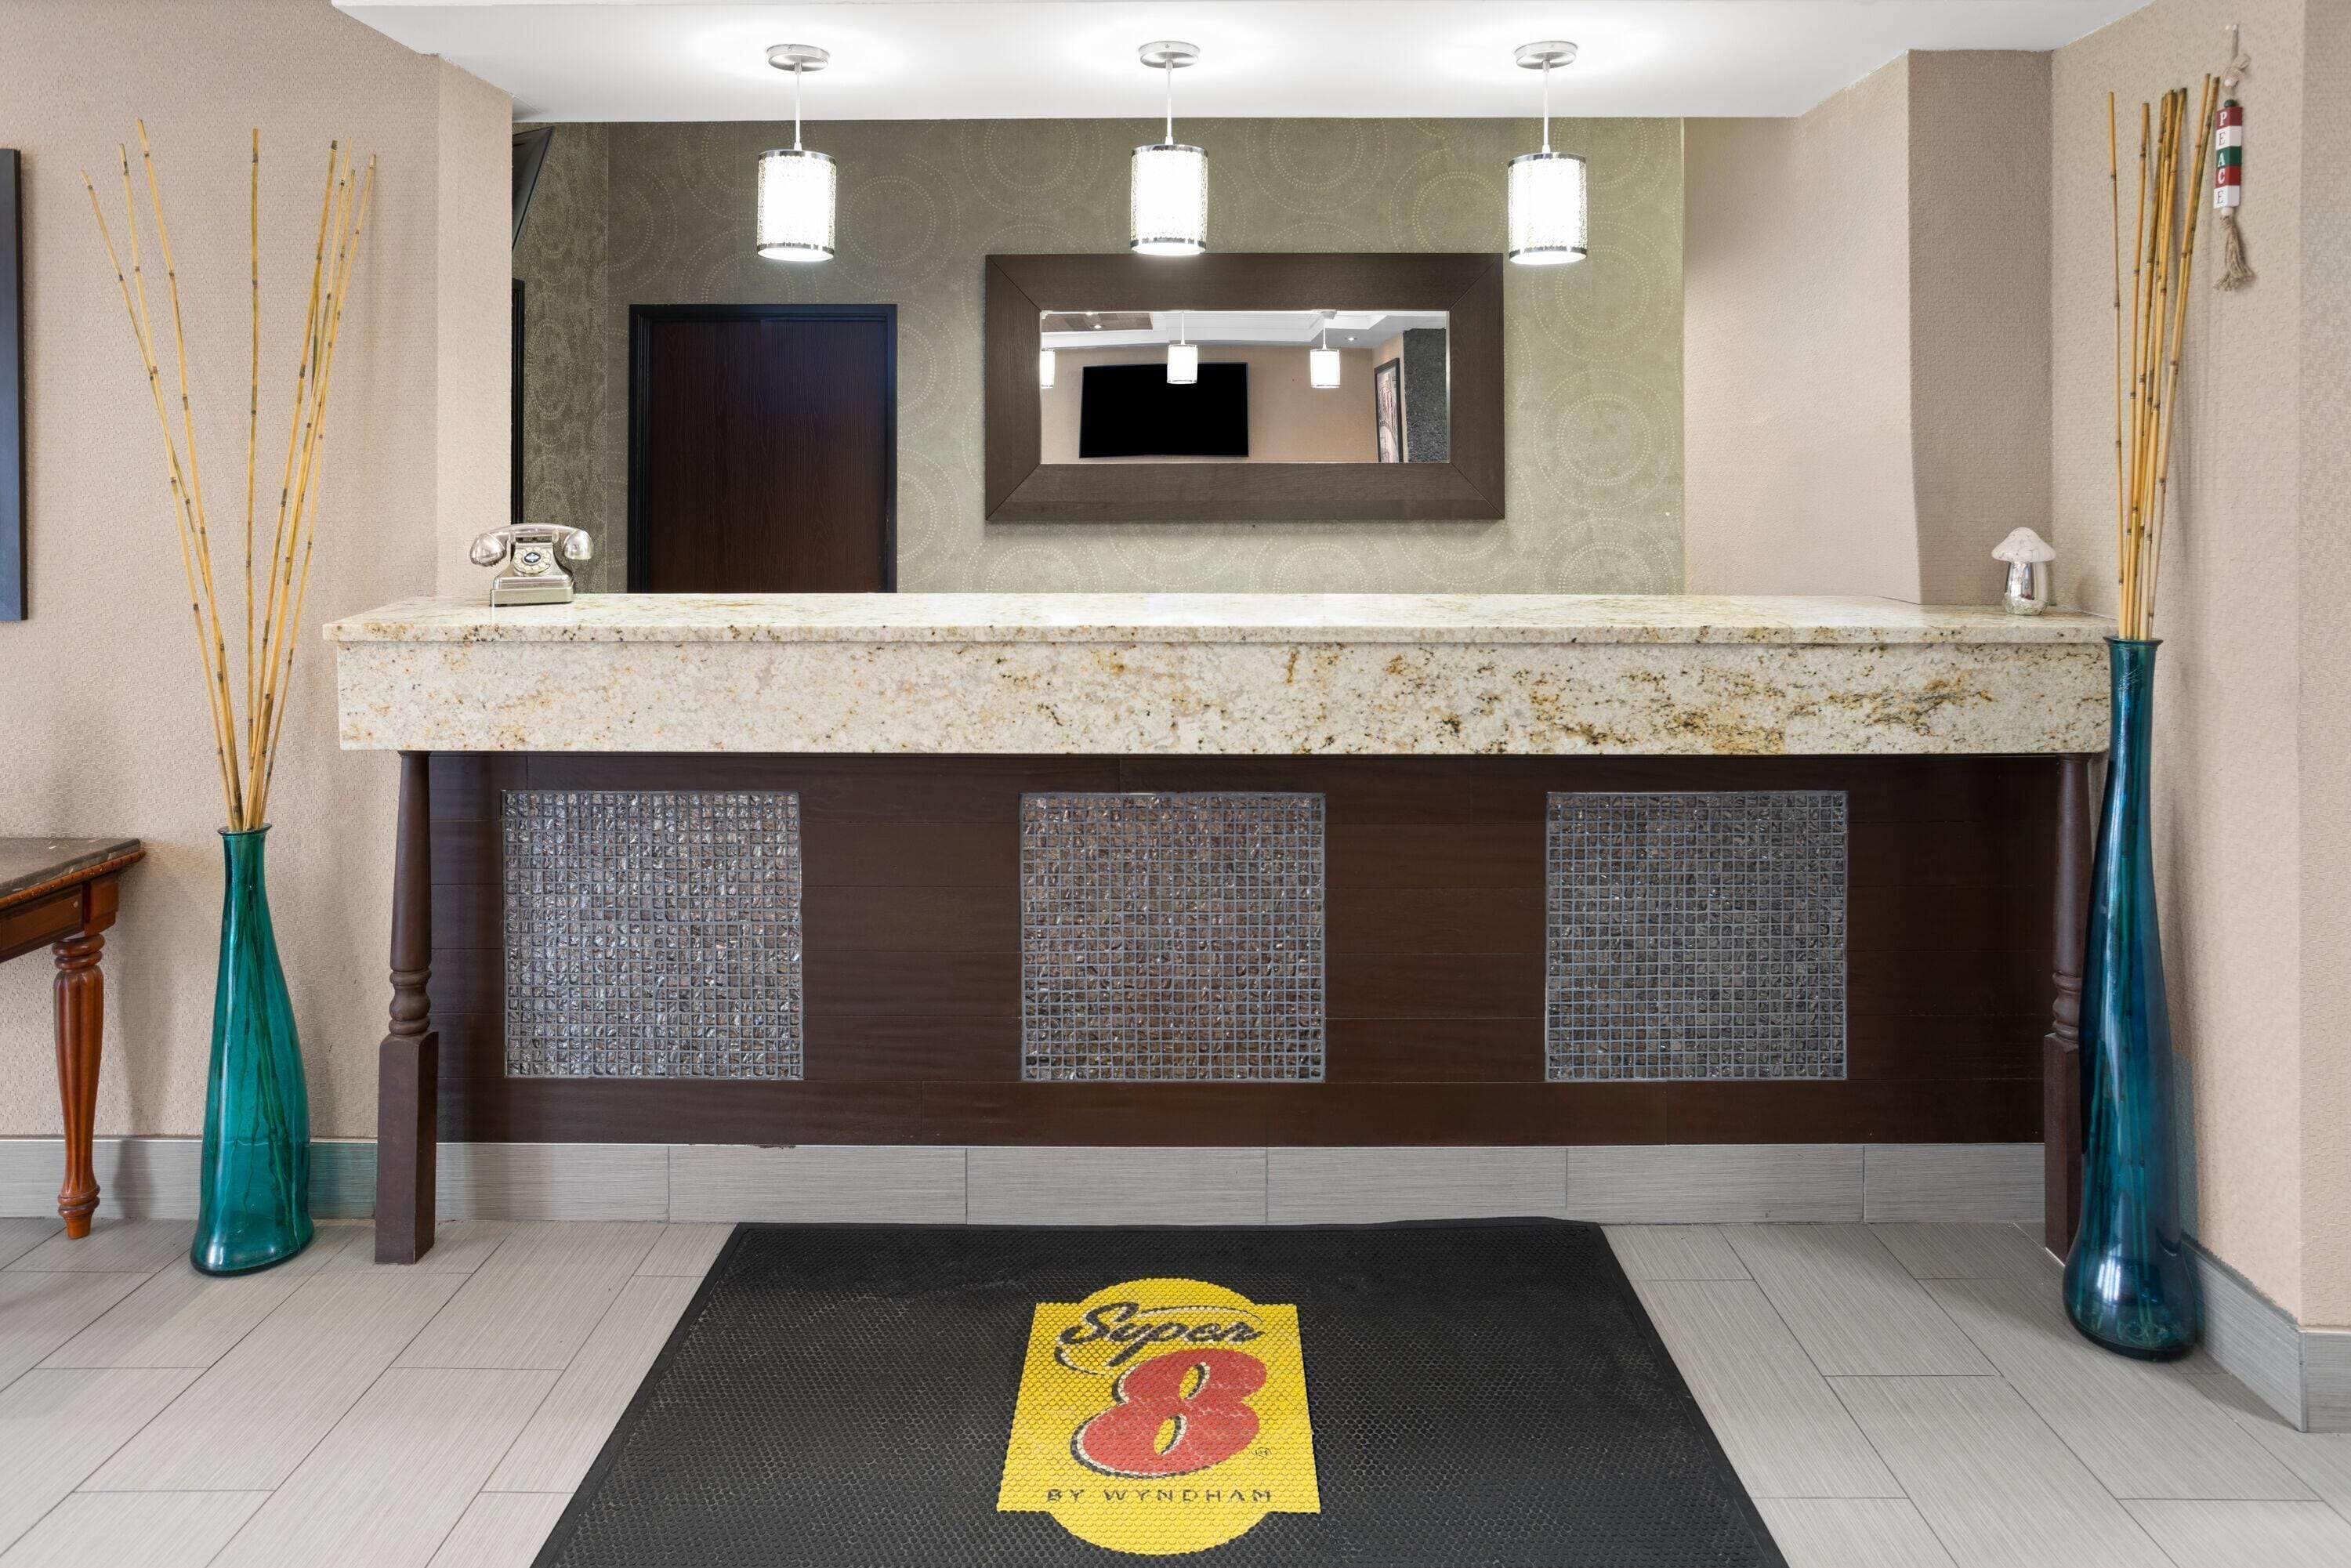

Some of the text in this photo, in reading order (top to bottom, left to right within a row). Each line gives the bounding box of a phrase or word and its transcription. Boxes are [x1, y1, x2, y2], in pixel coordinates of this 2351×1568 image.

[2216, 111, 2227, 204] PEACE
[1055, 1301, 1264, 1373] Super
[1070, 1348, 1266, 1479] 8
[1047, 1489, 1272, 1503] BY WYNDHAM
